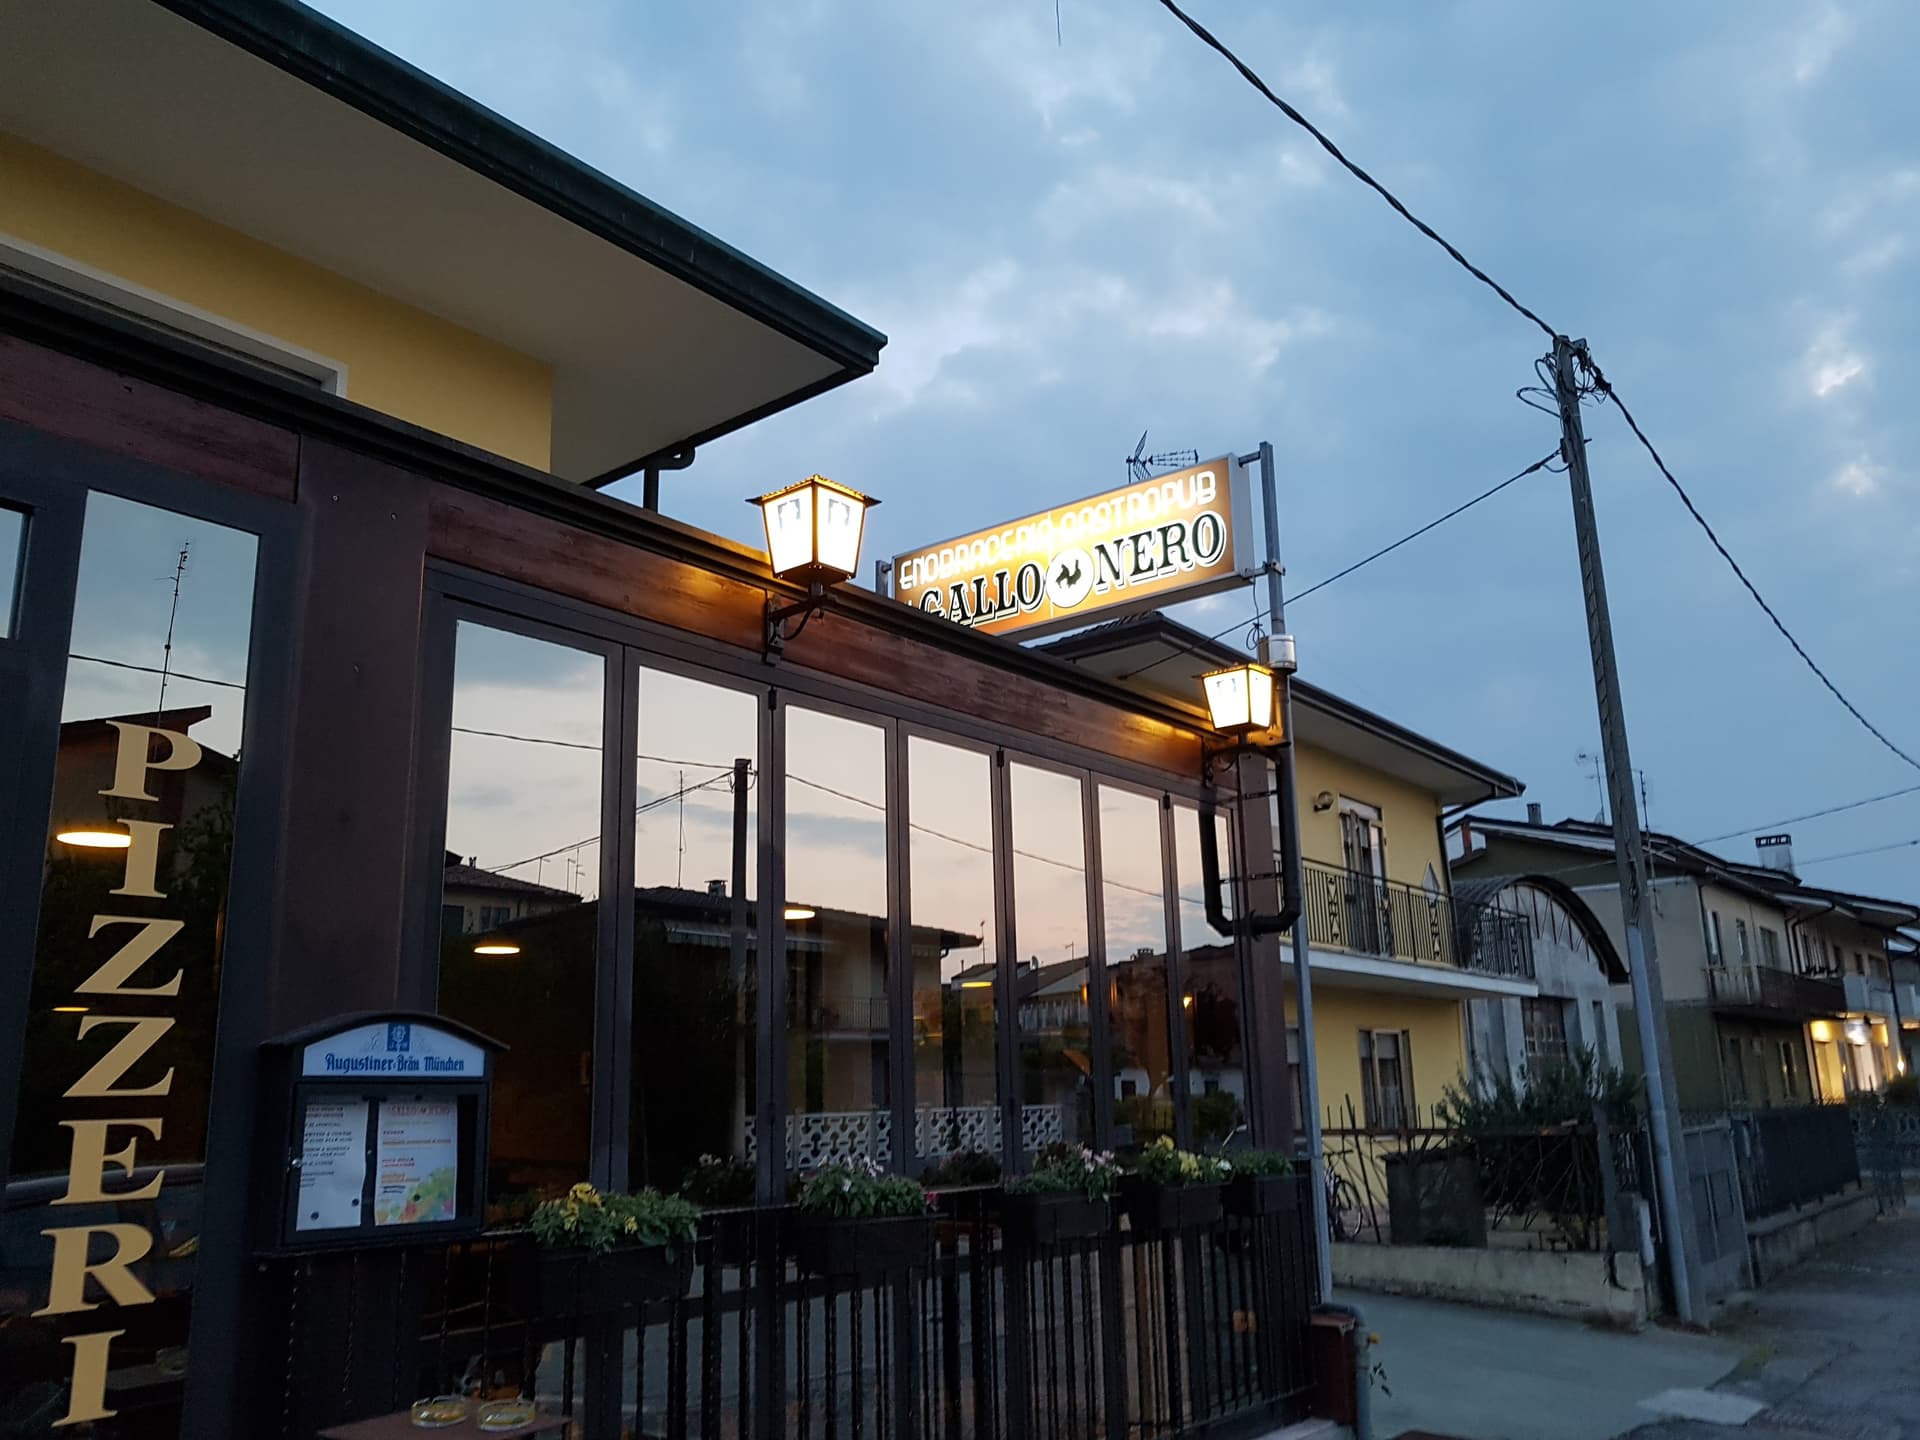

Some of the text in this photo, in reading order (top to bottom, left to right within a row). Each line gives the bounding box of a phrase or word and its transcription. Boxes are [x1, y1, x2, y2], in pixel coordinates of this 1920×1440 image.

[919, 512, 1228, 628] GALLO NERO
[30, 719, 203, 1430] PIZZERI
[424, 1056, 465, 1072] München
